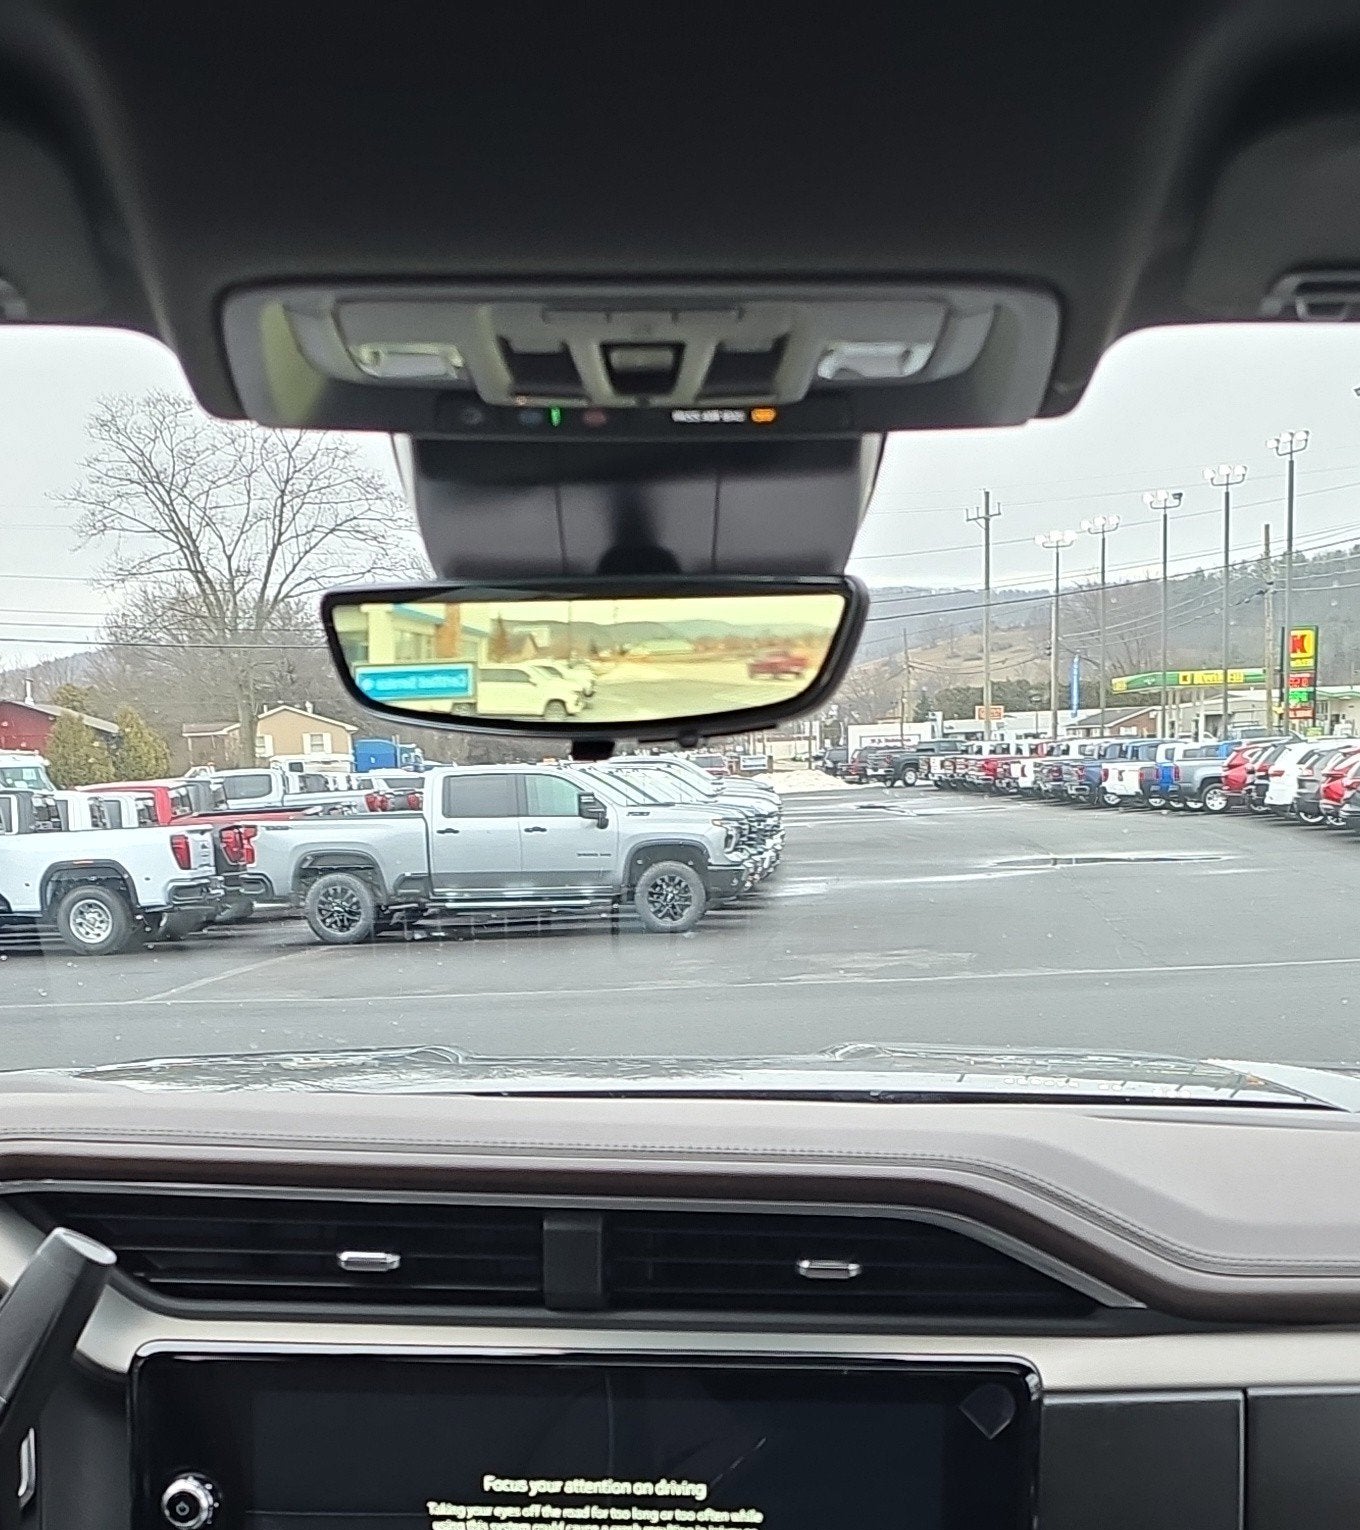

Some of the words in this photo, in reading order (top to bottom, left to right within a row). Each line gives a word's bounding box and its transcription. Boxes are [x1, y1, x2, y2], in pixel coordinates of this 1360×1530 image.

[483, 1475, 529, 1492] Focus
[529, 1480, 563, 1497] your
[564, 1478, 632, 1496] attention
[632, 1481, 654, 1496] on
[654, 1478, 707, 1500] driving
[426, 1501, 466, 1519] Taking
[466, 1506, 493, 1519] your
[493, 1506, 521, 1520] eyes
[521, 1504, 541, 1518] off
[541, 1504, 562, 1518] the
[562, 1505, 590, 1519] road
[590, 1505, 609, 1519] for
[609, 1507, 631, 1520] too
[631, 1506, 659, 1523] long
[659, 1510, 674, 1521] or
[674, 1508, 696, 1521] too
[696, 1507, 730, 1522] often
[730, 1508, 764, 1524] while
